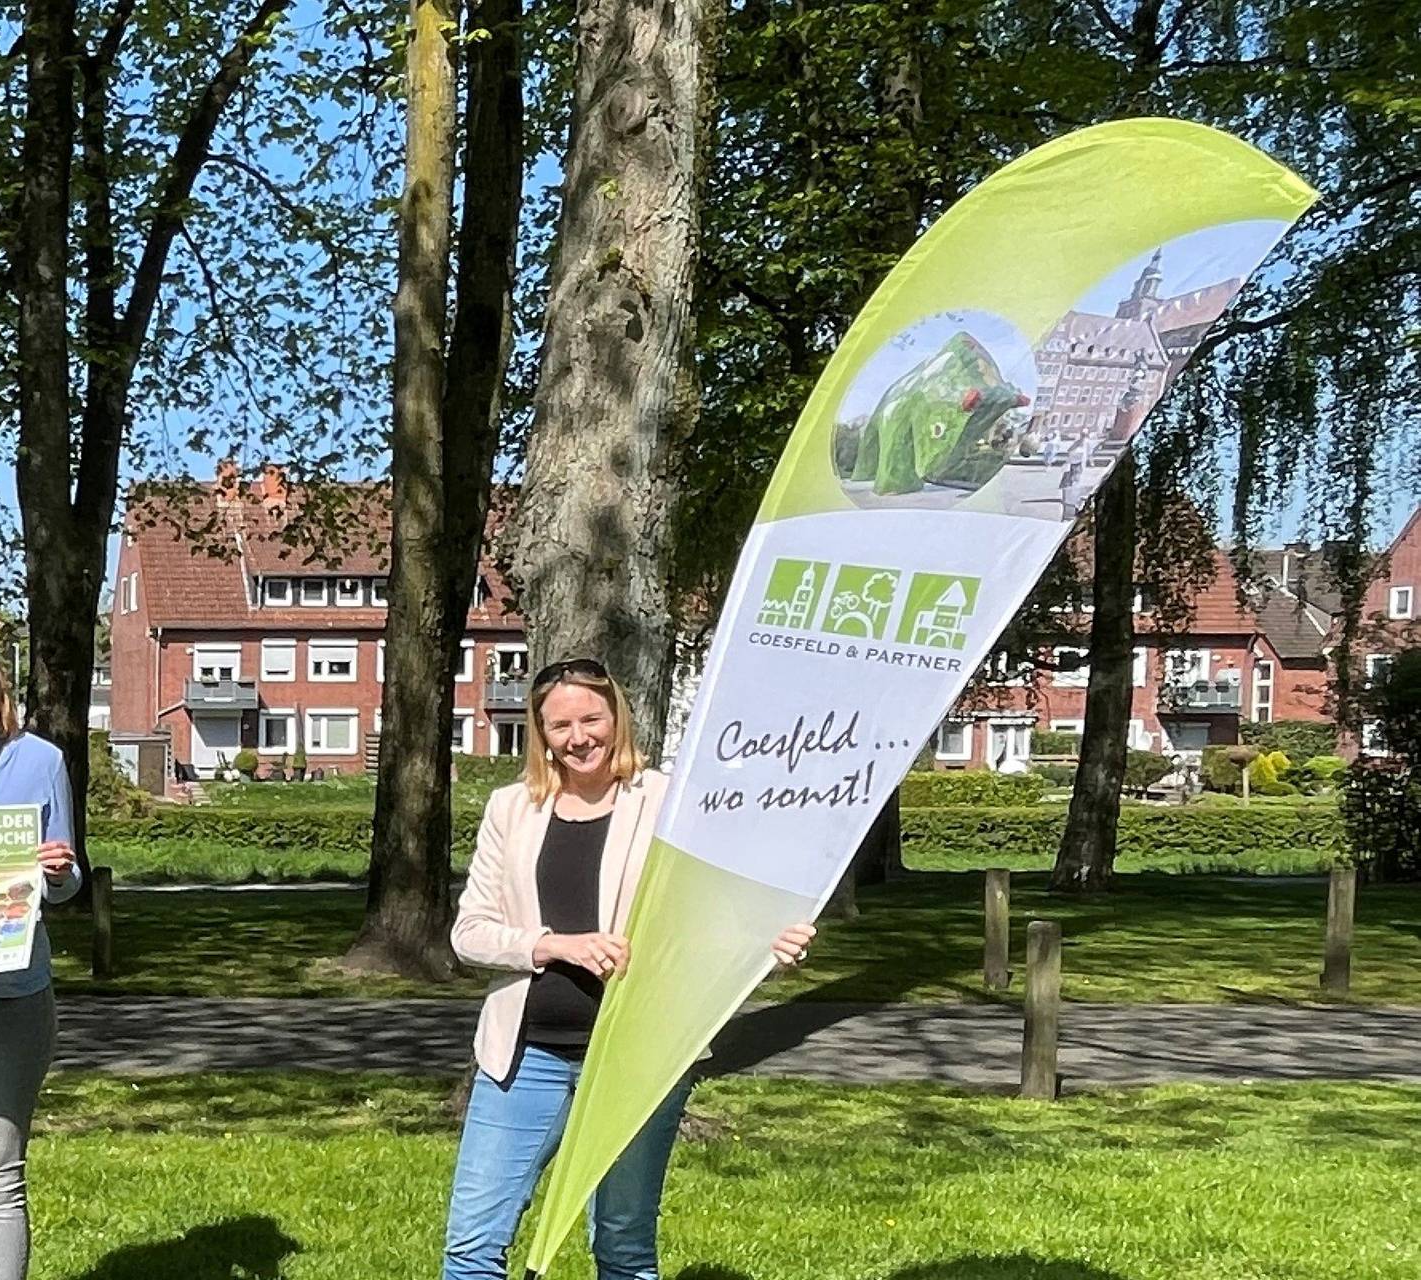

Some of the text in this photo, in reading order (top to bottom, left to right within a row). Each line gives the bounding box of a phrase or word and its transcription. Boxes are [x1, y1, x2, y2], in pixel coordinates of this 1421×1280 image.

[748, 632, 963, 672] COESFELD & PARTNER
[716, 710, 860, 773] Coesfeld
[698, 760, 875, 814] wo sonst!
